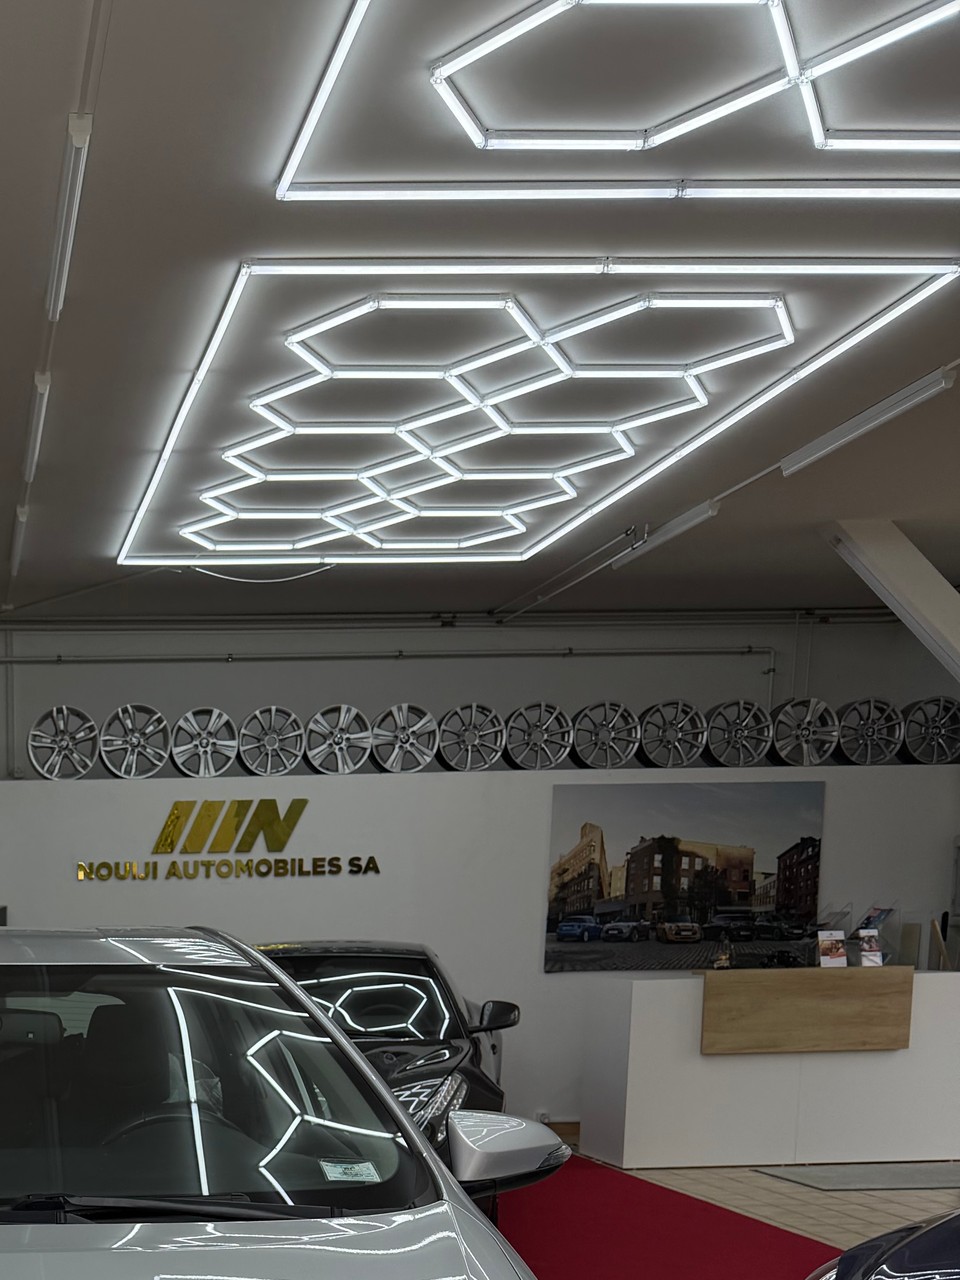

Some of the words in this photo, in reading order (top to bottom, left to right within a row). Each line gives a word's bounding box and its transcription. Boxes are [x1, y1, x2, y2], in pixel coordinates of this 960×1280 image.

[76, 860, 158, 881] NOUIJI
[165, 857, 342, 880] AUTOMOBILES
[348, 856, 381, 875] SA
